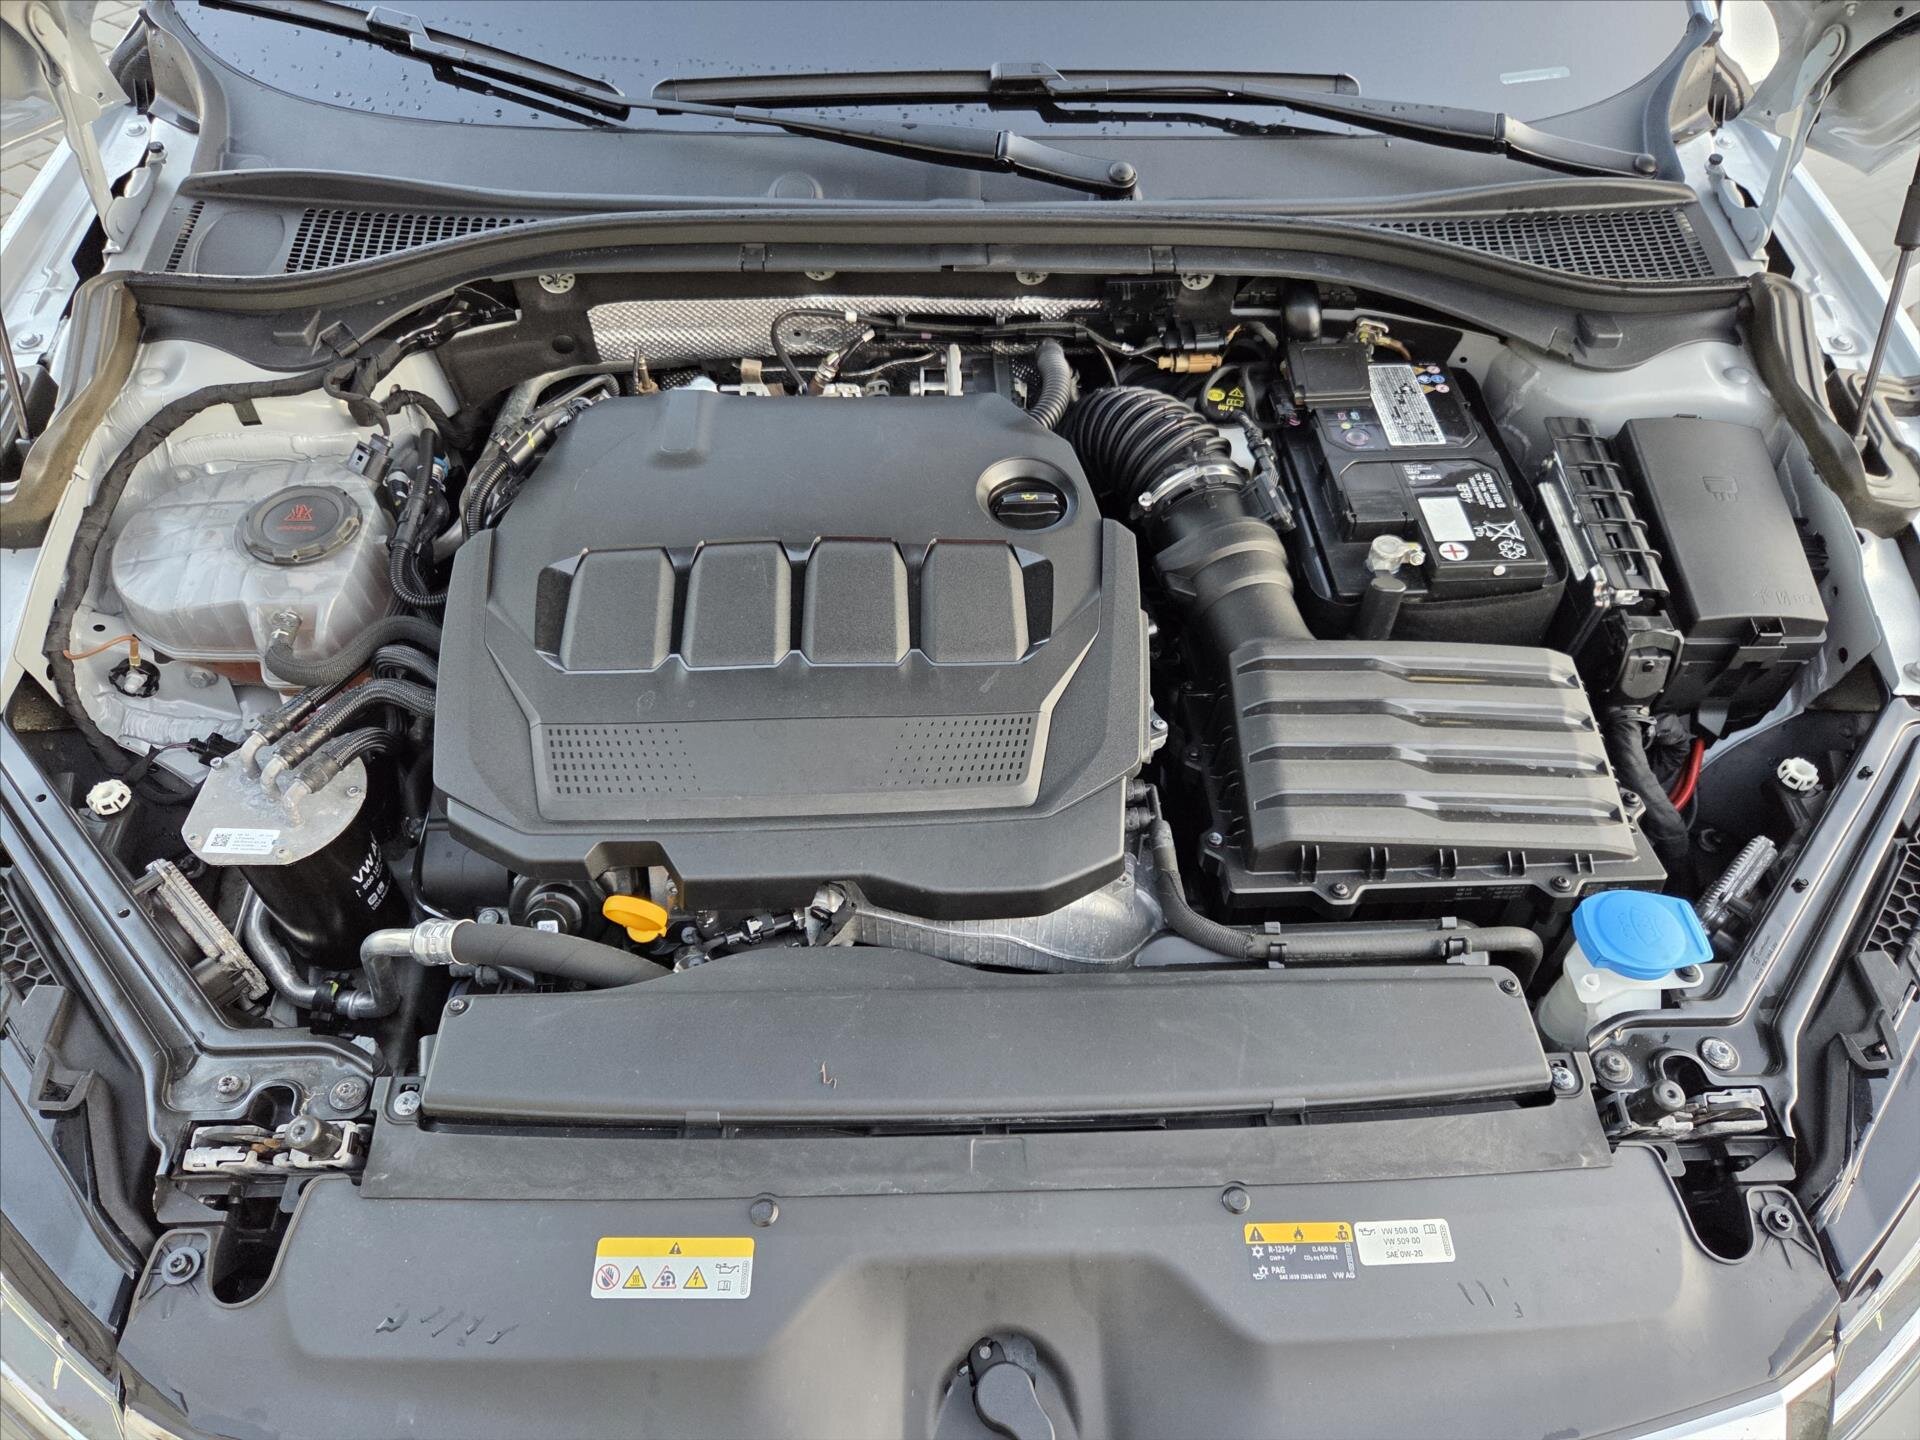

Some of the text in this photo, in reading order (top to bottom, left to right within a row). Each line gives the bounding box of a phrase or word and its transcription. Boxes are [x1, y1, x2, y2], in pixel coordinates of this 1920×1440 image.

[351, 852, 374, 883] VW
[1381, 1226, 1419, 1235] VW 508 00
[1383, 1236, 1421, 1246] VW 509 00
[1268, 1244, 1297, 1254] R-1234yf
[1385, 1249, 1424, 1259] SAE 0W-20
[1271, 1265, 1286, 1274] PAG
[1332, 1271, 1344, 1279] VW
[1345, 1271, 1356, 1279] AG
